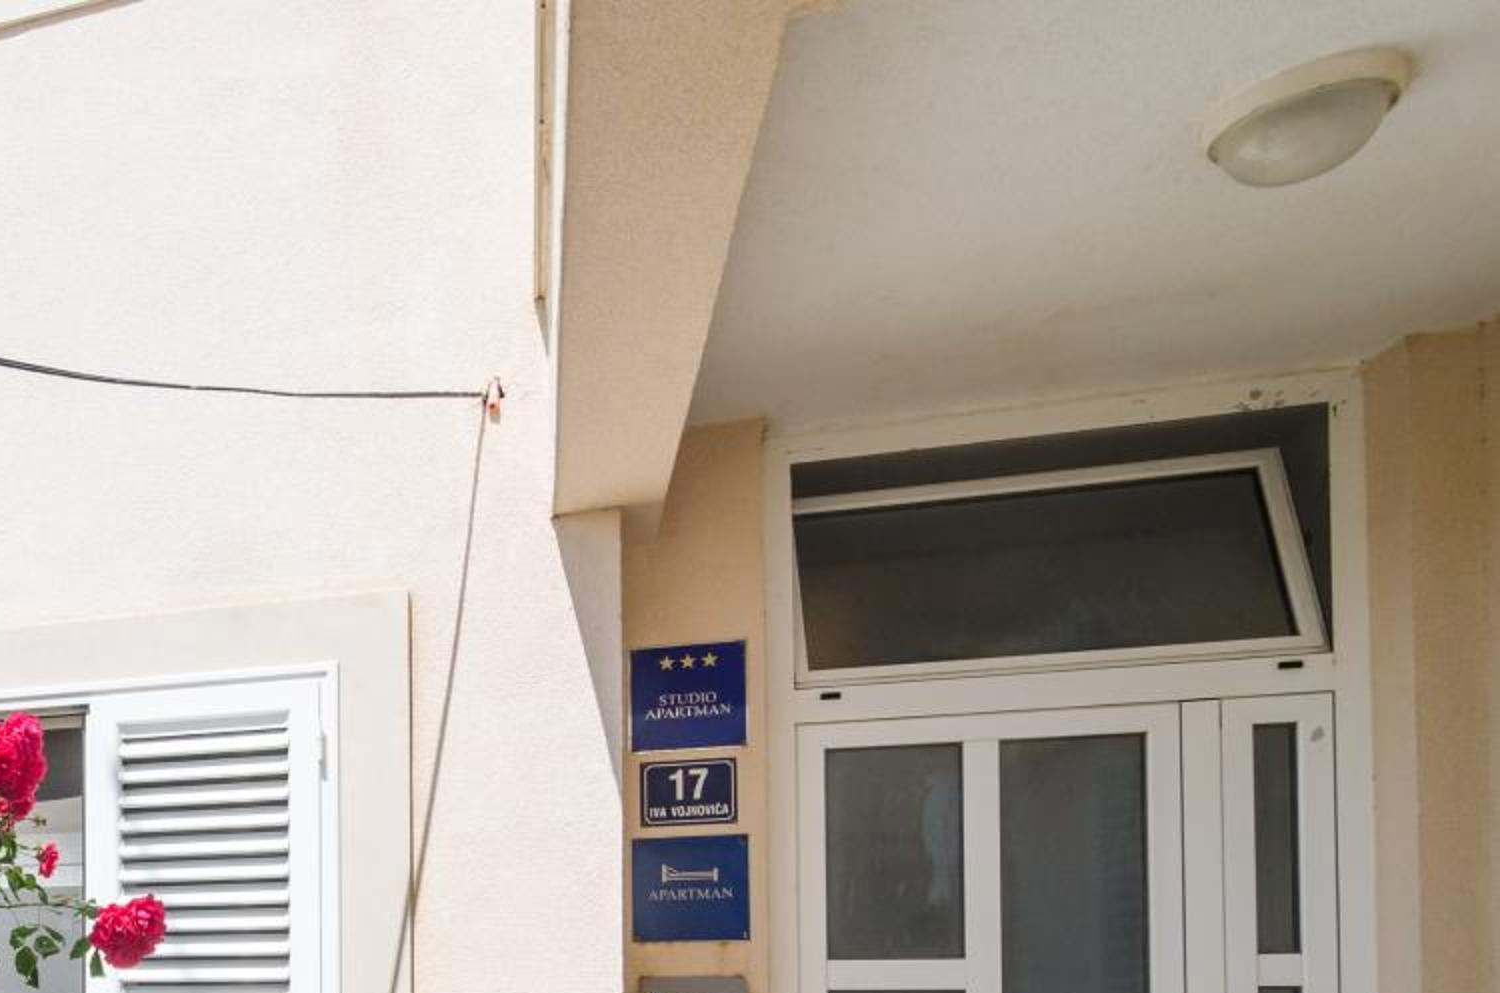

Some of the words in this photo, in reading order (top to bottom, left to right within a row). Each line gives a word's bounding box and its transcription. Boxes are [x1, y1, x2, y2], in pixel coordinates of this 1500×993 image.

[658, 691, 717, 707] STUDIO
[644, 703, 732, 720] APARTMAN
[668, 768, 709, 801] 17
[649, 806, 667, 818] IVA
[647, 886, 734, 902] APARTMAN
